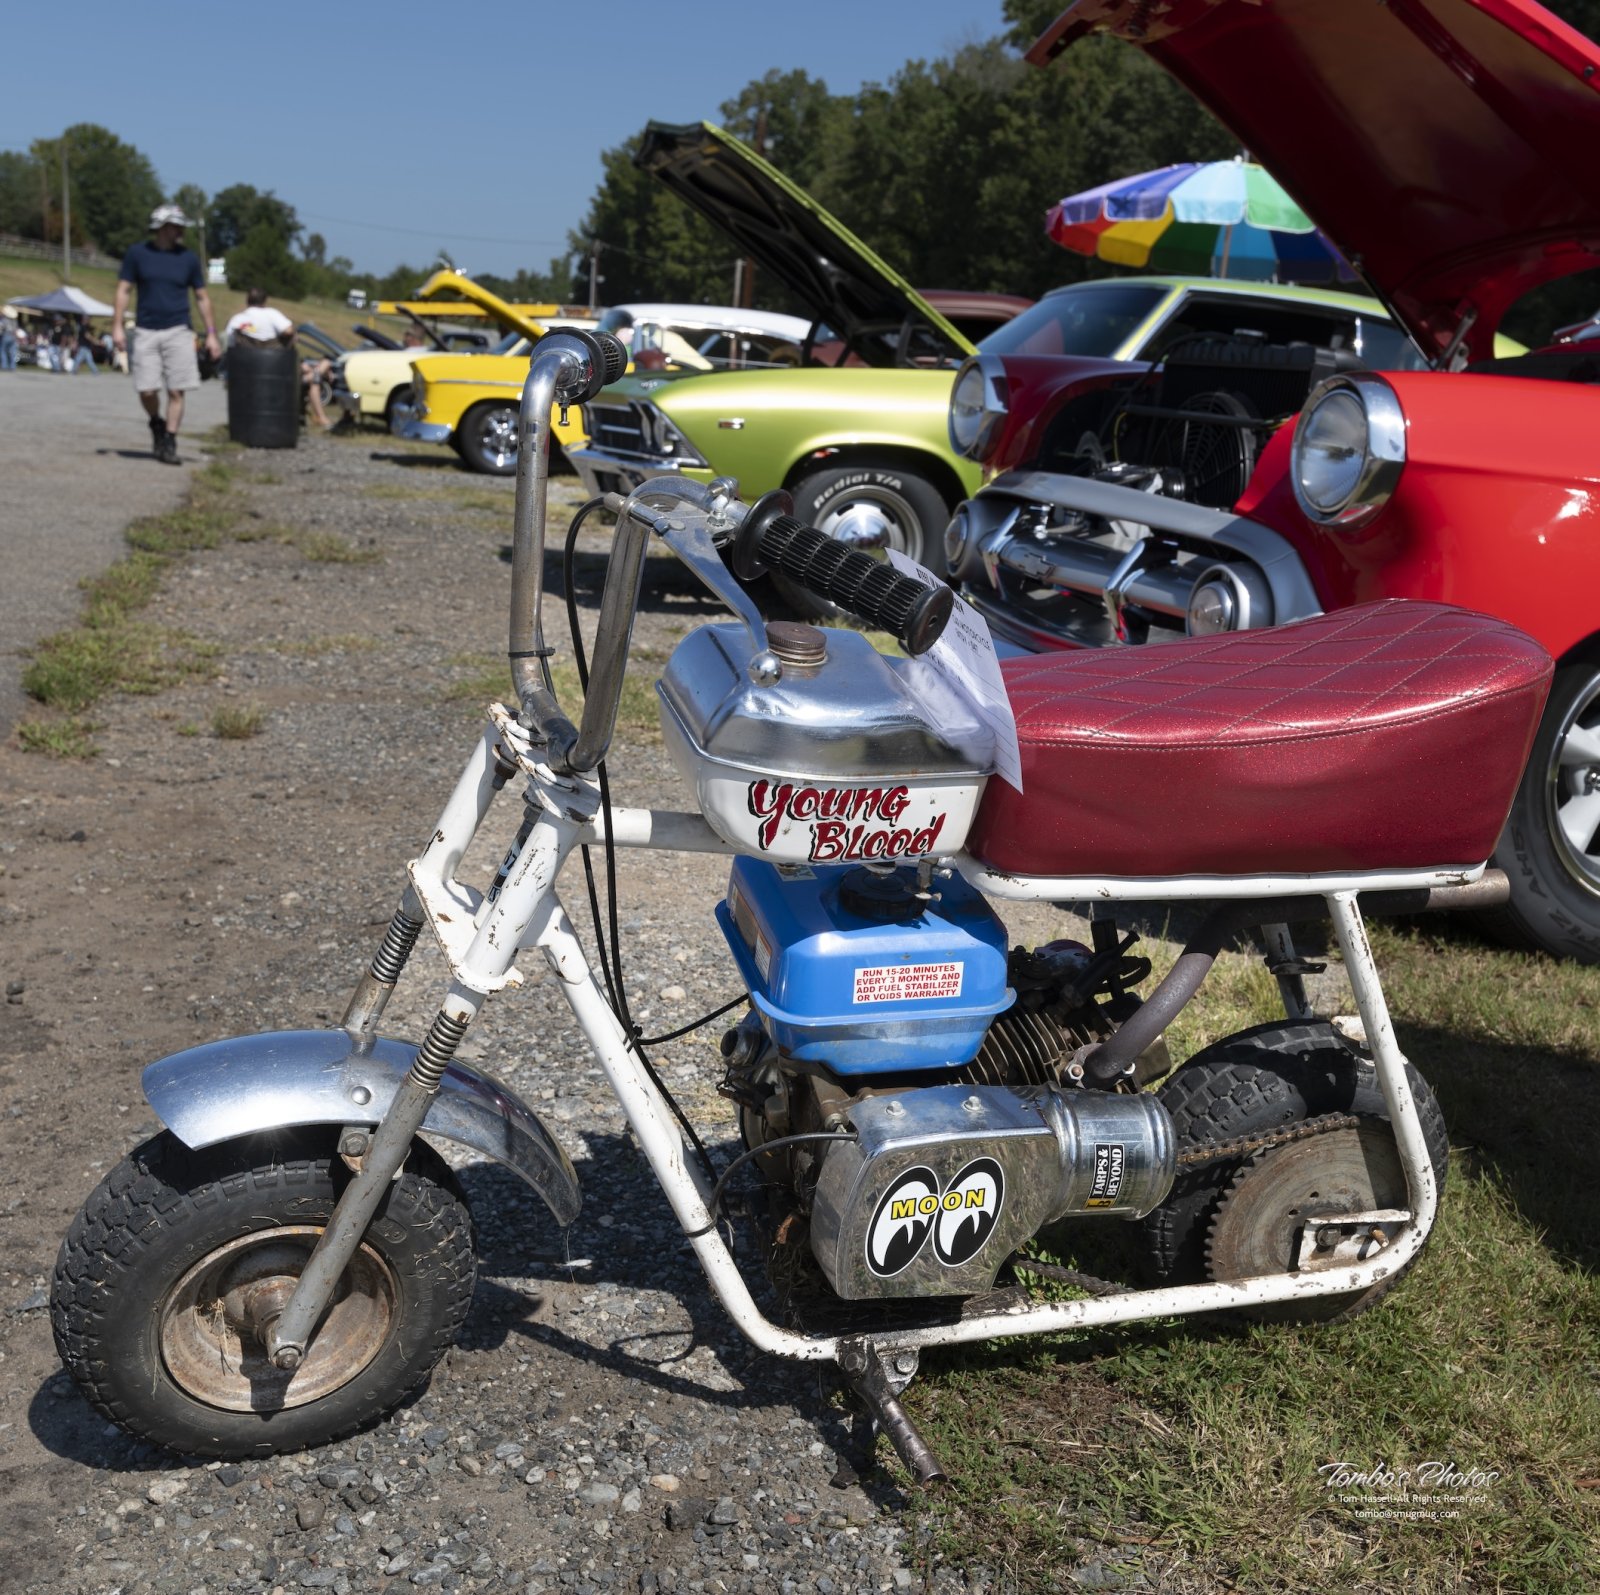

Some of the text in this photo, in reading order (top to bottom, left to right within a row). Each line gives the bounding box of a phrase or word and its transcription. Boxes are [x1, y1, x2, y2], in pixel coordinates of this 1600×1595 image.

[814, 473, 902, 509] Radial T/A
[856, 972, 961, 986] EVERY 3 MONTHS AND
[862, 964, 956, 978] RUN 15-20 MINUTES
[856, 981, 959, 994] ADD FUEL STABILIZER
[857, 994, 870, 1002] OR
[873, 992, 902, 1001] VOIDS
[1092, 1148, 1109, 1196] TARPS &
[1106, 1148, 1122, 1196] BEYOND
[891, 1187, 986, 1220] MOON
